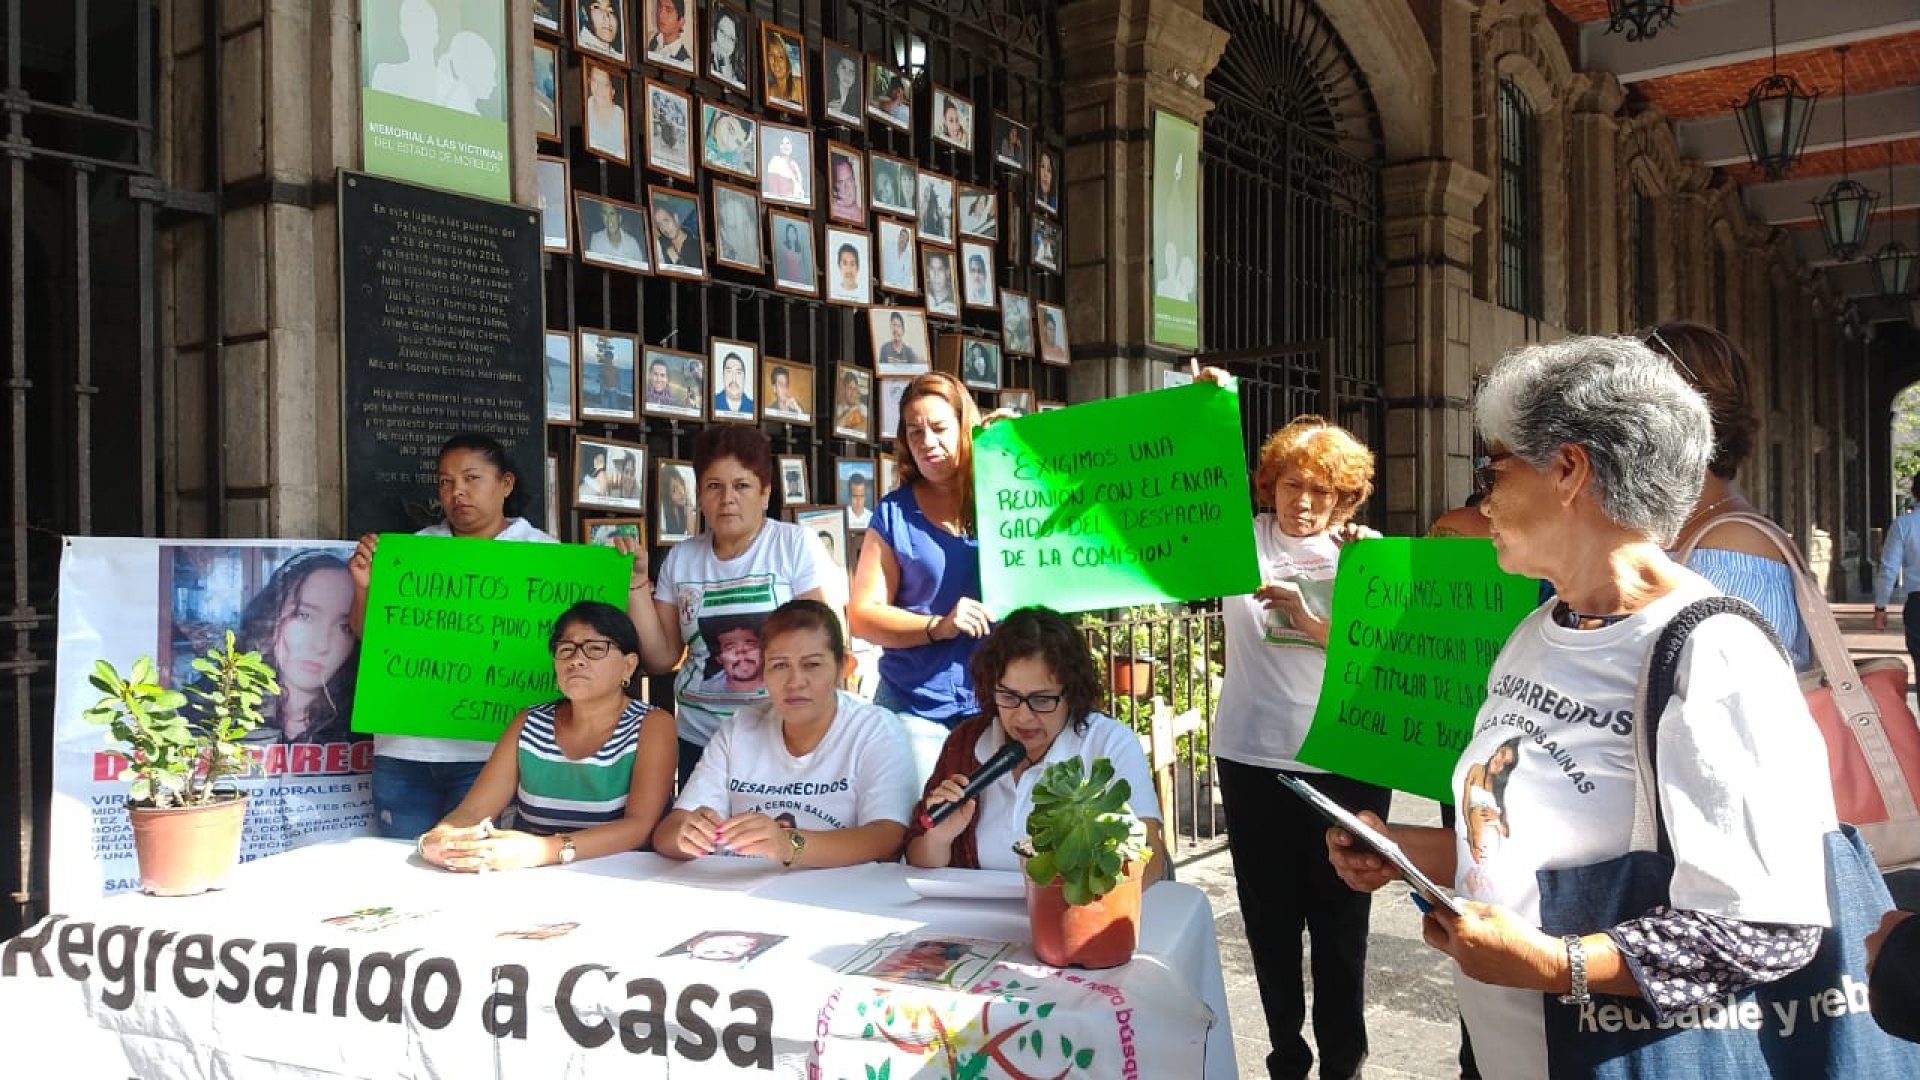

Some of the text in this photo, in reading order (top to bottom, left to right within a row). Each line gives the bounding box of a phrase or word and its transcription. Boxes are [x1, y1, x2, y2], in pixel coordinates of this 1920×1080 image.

[369, 121, 425, 143] MEMORIAL
[427, 135, 434, 145] A
[435, 137, 457, 150] LAS
[374, 136, 393, 150] DEL
[396, 142, 436, 159] ESTADO
[1129, 437, 1174, 463] UNA
[996, 486, 1085, 511] REUNION
[1094, 482, 1133, 503] CON
[1141, 478, 1163, 498] EL
[999, 502, 1222, 538] GADO DEL DESPACHO
[1001, 549, 1026, 568] DE
[1039, 547, 1062, 567] LA
[1449, 581, 1475, 610] VER
[1484, 580, 1504, 613] LA
[383, 604, 484, 635] FEDERALES
[491, 615, 530, 639] PIDIO
[1347, 619, 1500, 668] CONVOCATORIA PAR
[485, 665, 560, 694] ASIGNA
[1343, 660, 1363, 686] EL
[1372, 665, 1427, 698] TITULAR
[1433, 676, 1453, 703] DE
[1457, 682, 1474, 708] LA
[450, 698, 517, 725] ESTAD
[1337, 700, 1388, 736] LOCAL
[1402, 716, 1424, 746] DE
[269, 784, 352, 798] MORALES
[730, 777, 849, 796] DESAPARECIDOS
[765, 800, 802, 811] CERON
[2, 914, 462, 1030] Regresando
[482, 963, 528, 1040] a
[555, 963, 775, 1071] Casa
[1773, 1000, 1799, 1037] y
